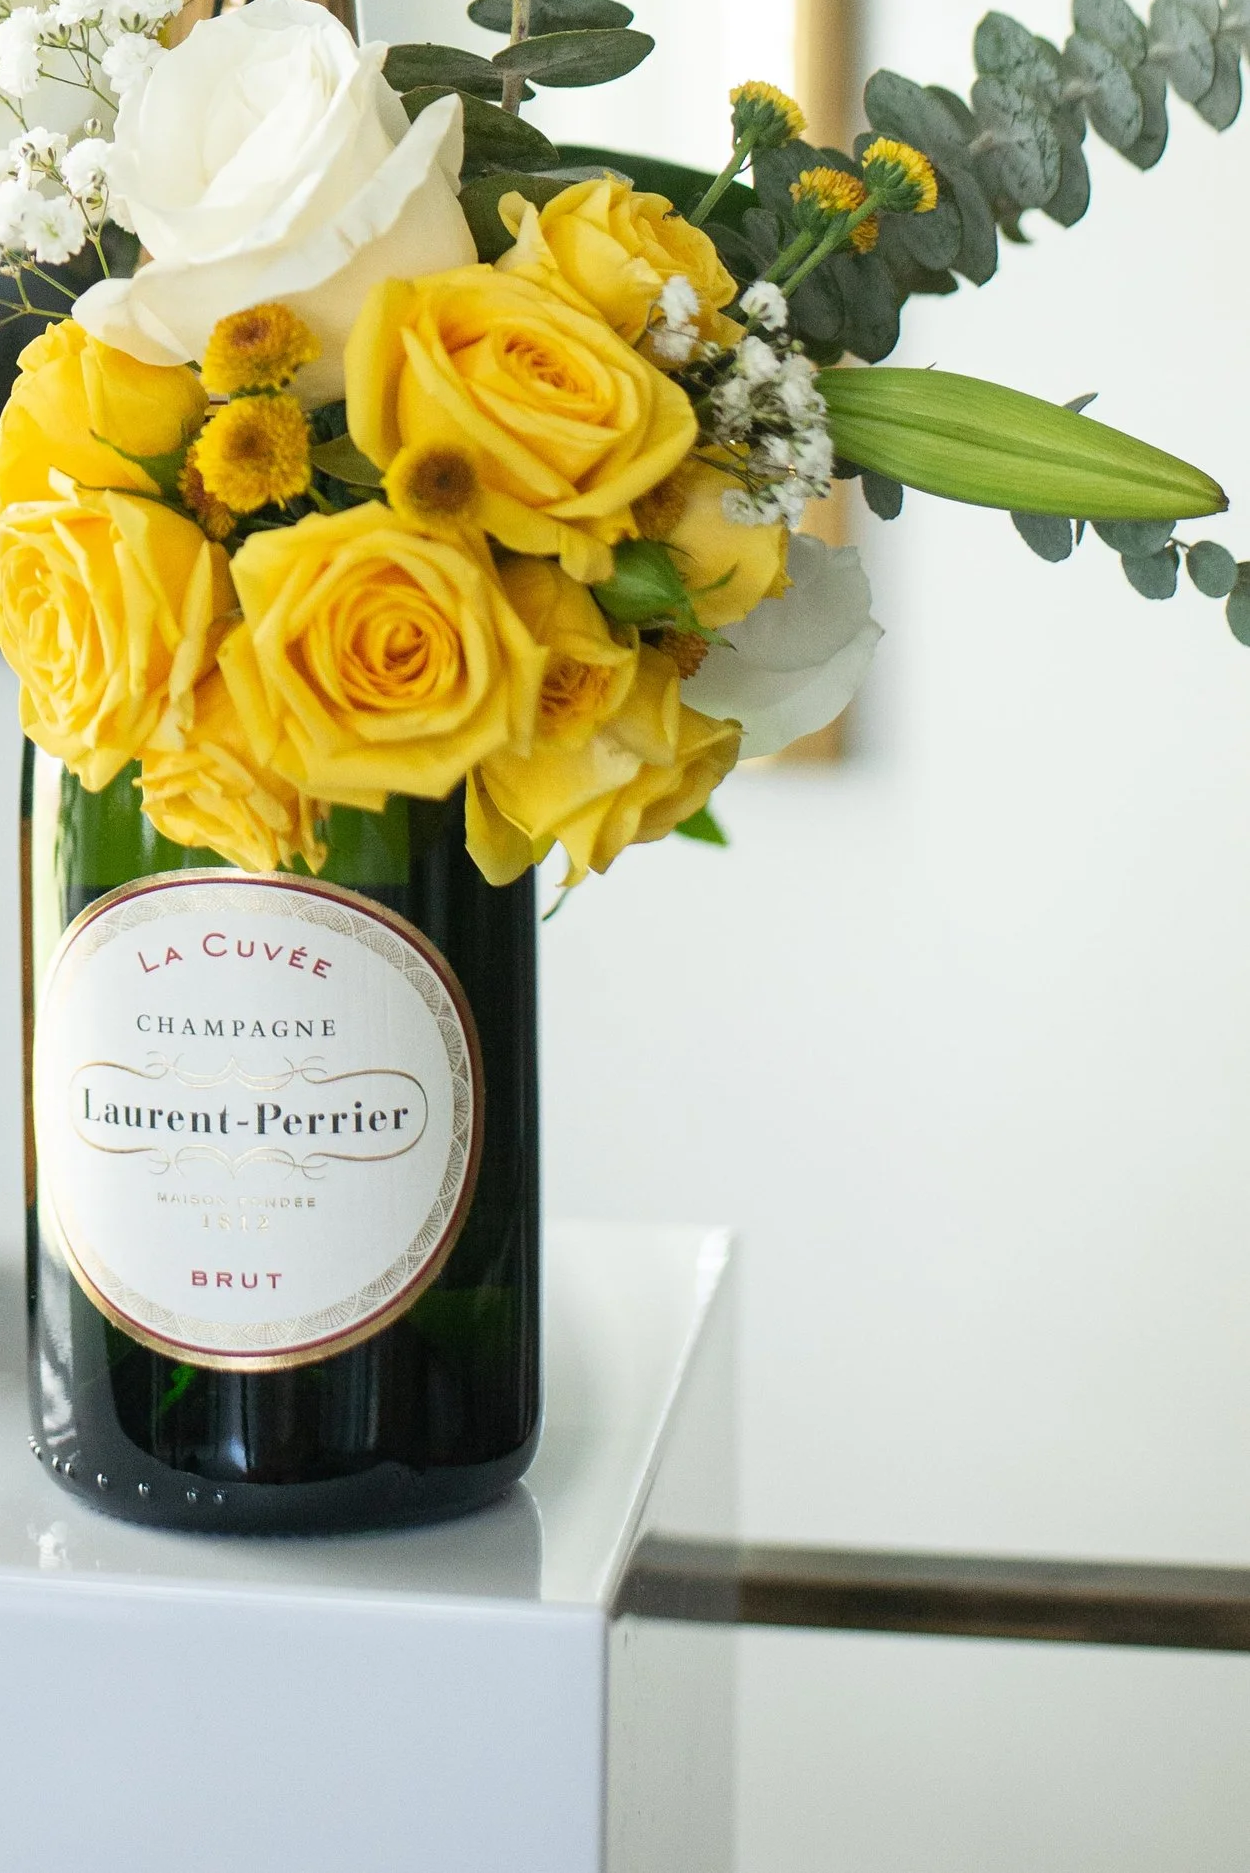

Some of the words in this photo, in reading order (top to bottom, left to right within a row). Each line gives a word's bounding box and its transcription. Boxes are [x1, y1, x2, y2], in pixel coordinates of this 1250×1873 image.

[138, 946, 184, 973] LA
[202, 932, 332, 979] CUVÉE
[136, 1014, 336, 1038] CHAMPAGNE
[82, 1087, 410, 1136] Laurent-Perrier
[201, 1212, 270, 1233] 1812
[191, 1270, 283, 1290] BRUT
